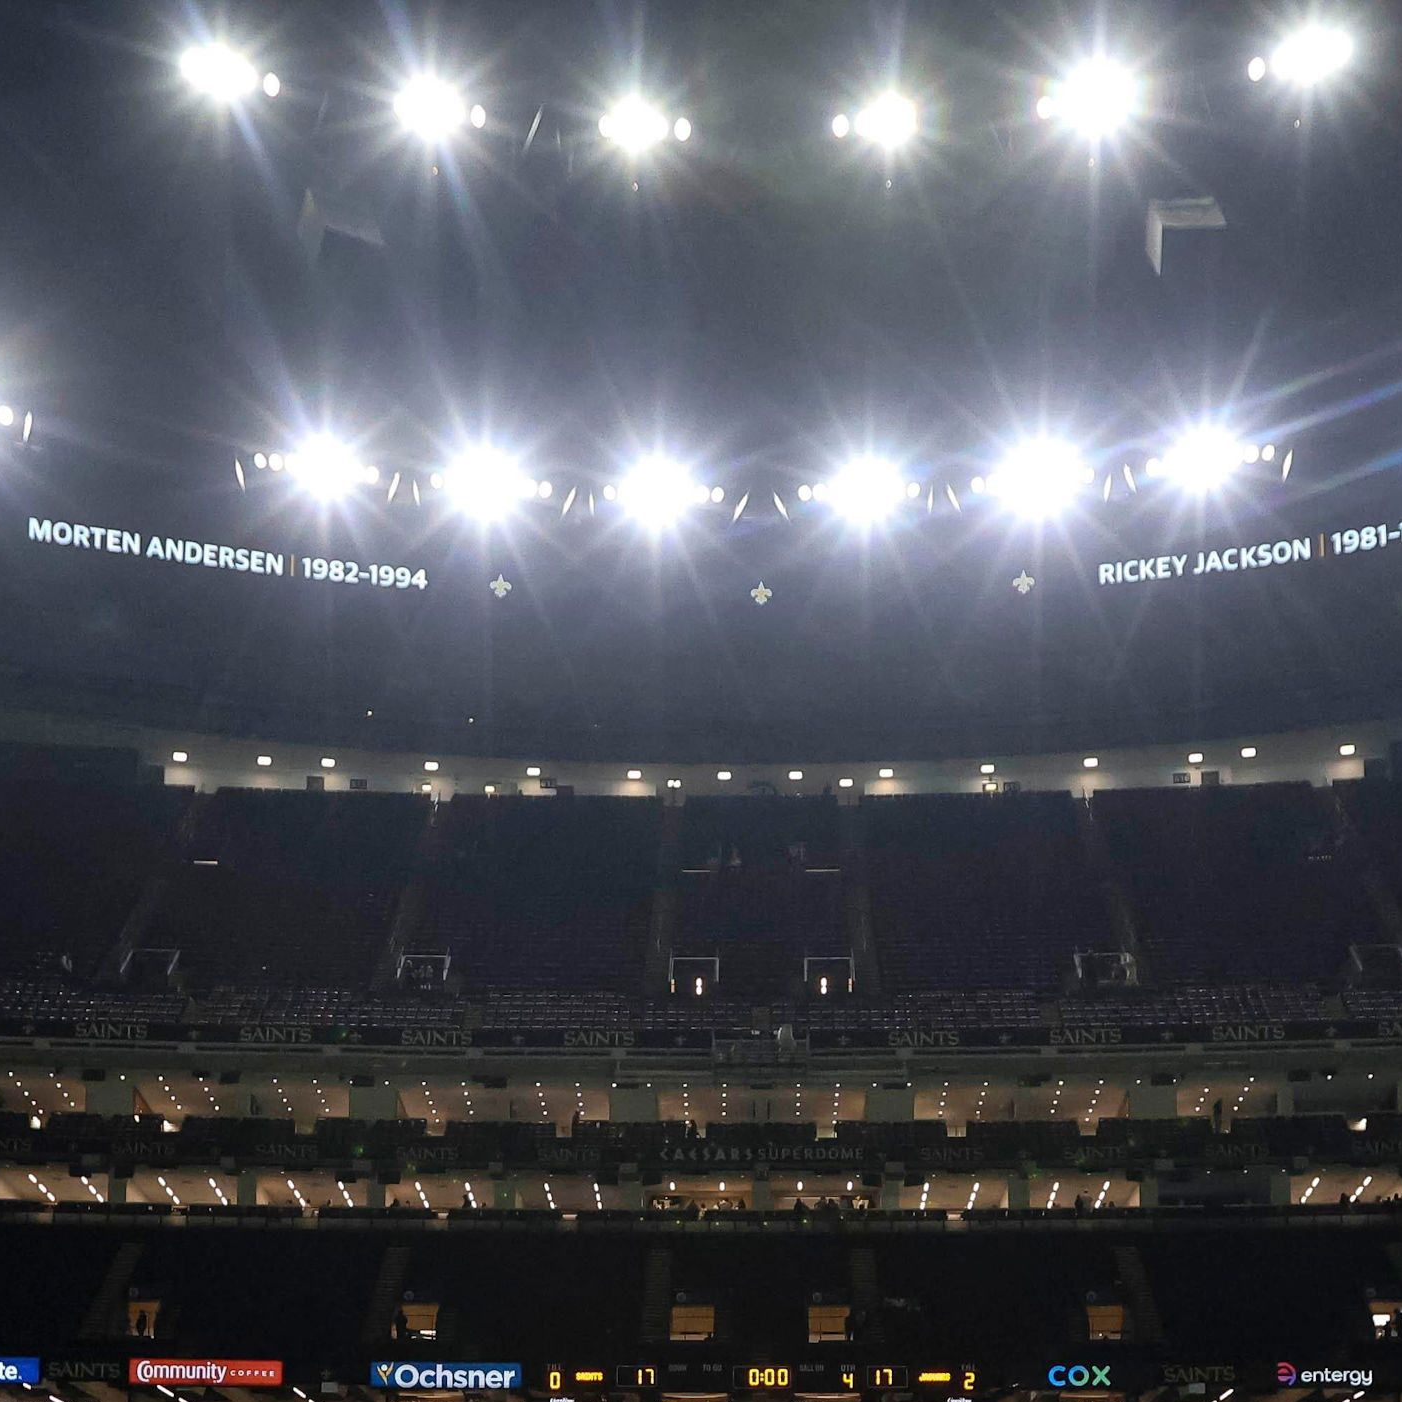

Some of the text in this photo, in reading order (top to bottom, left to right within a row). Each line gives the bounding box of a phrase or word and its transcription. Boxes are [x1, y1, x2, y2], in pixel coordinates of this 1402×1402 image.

[28, 517, 428, 590] MORTEN ANDERSEN 1982-1994
[1099, 553, 1187, 585] RICKEY
[1193, 537, 1311, 576] JACKSON
[137, 1360, 275, 1383] Community COFFEE
[394, 1364, 515, 1389] Ochsner
[637, 1369, 655, 1385] 17
[749, 1368, 788, 1386] 0:00
[875, 1369, 892, 1385] 17
[1048, 1365, 1111, 1386] COX
[1300, 1368, 1373, 1386] entergy
[550, 1372, 561, 1390] 0
[843, 1373, 854, 1389] 4
[963, 1373, 975, 1390] 2
